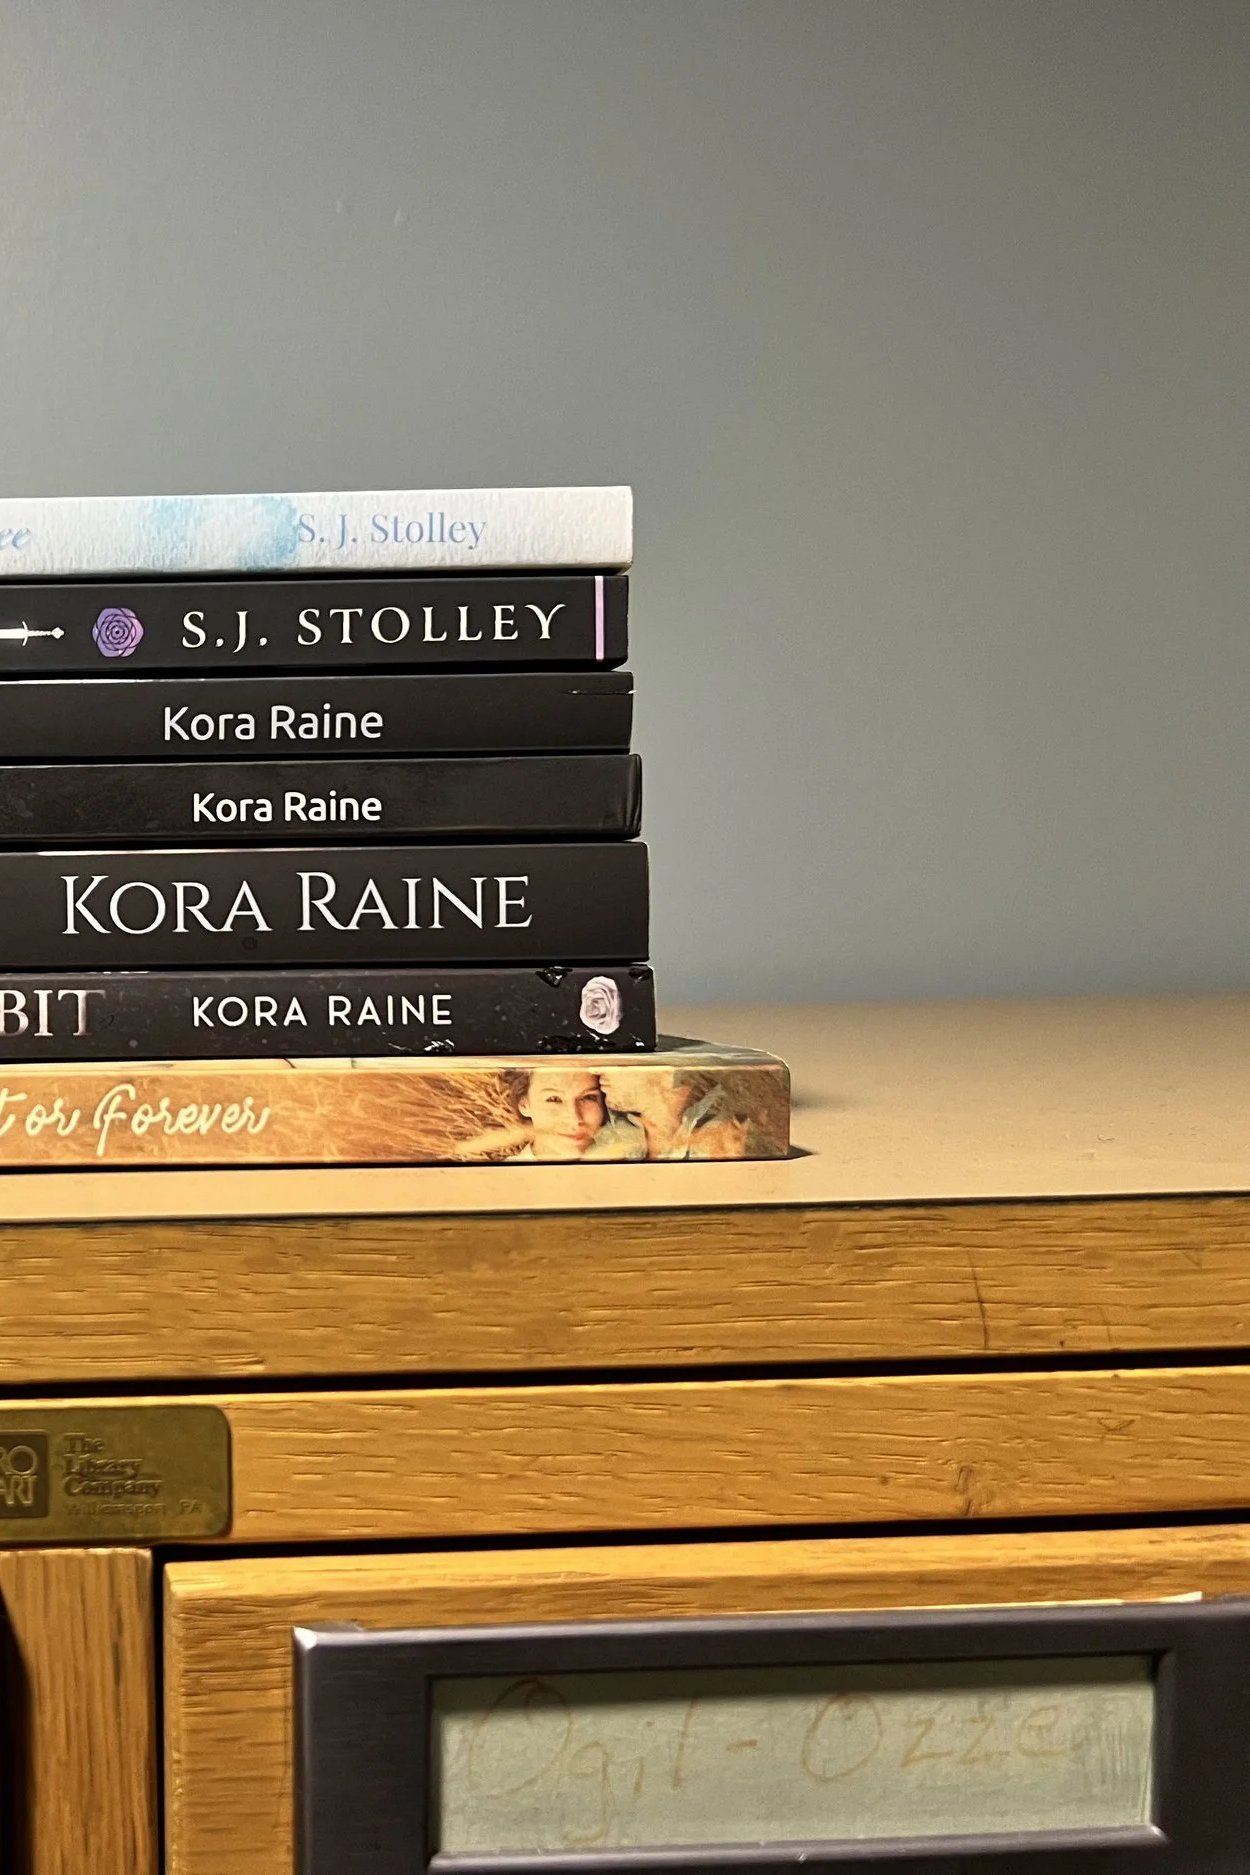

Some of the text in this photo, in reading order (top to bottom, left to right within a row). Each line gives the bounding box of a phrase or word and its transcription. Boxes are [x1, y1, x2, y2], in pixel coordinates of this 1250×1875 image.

[299, 512, 487, 550] S. J. Stolley
[182, 603, 567, 654] S.J. STOLLEY
[164, 703, 384, 741] Kora Raine
[193, 790, 383, 823] Kora Raine
[60, 871, 533, 935] KORA RAINE
[192, 994, 453, 1028] KORA RAINE
[25, 1103, 80, 1137] or
[94, 1083, 272, 1156] Forever
[63, 1432, 104, 1452] The
[63, 1475, 163, 1498] Company
